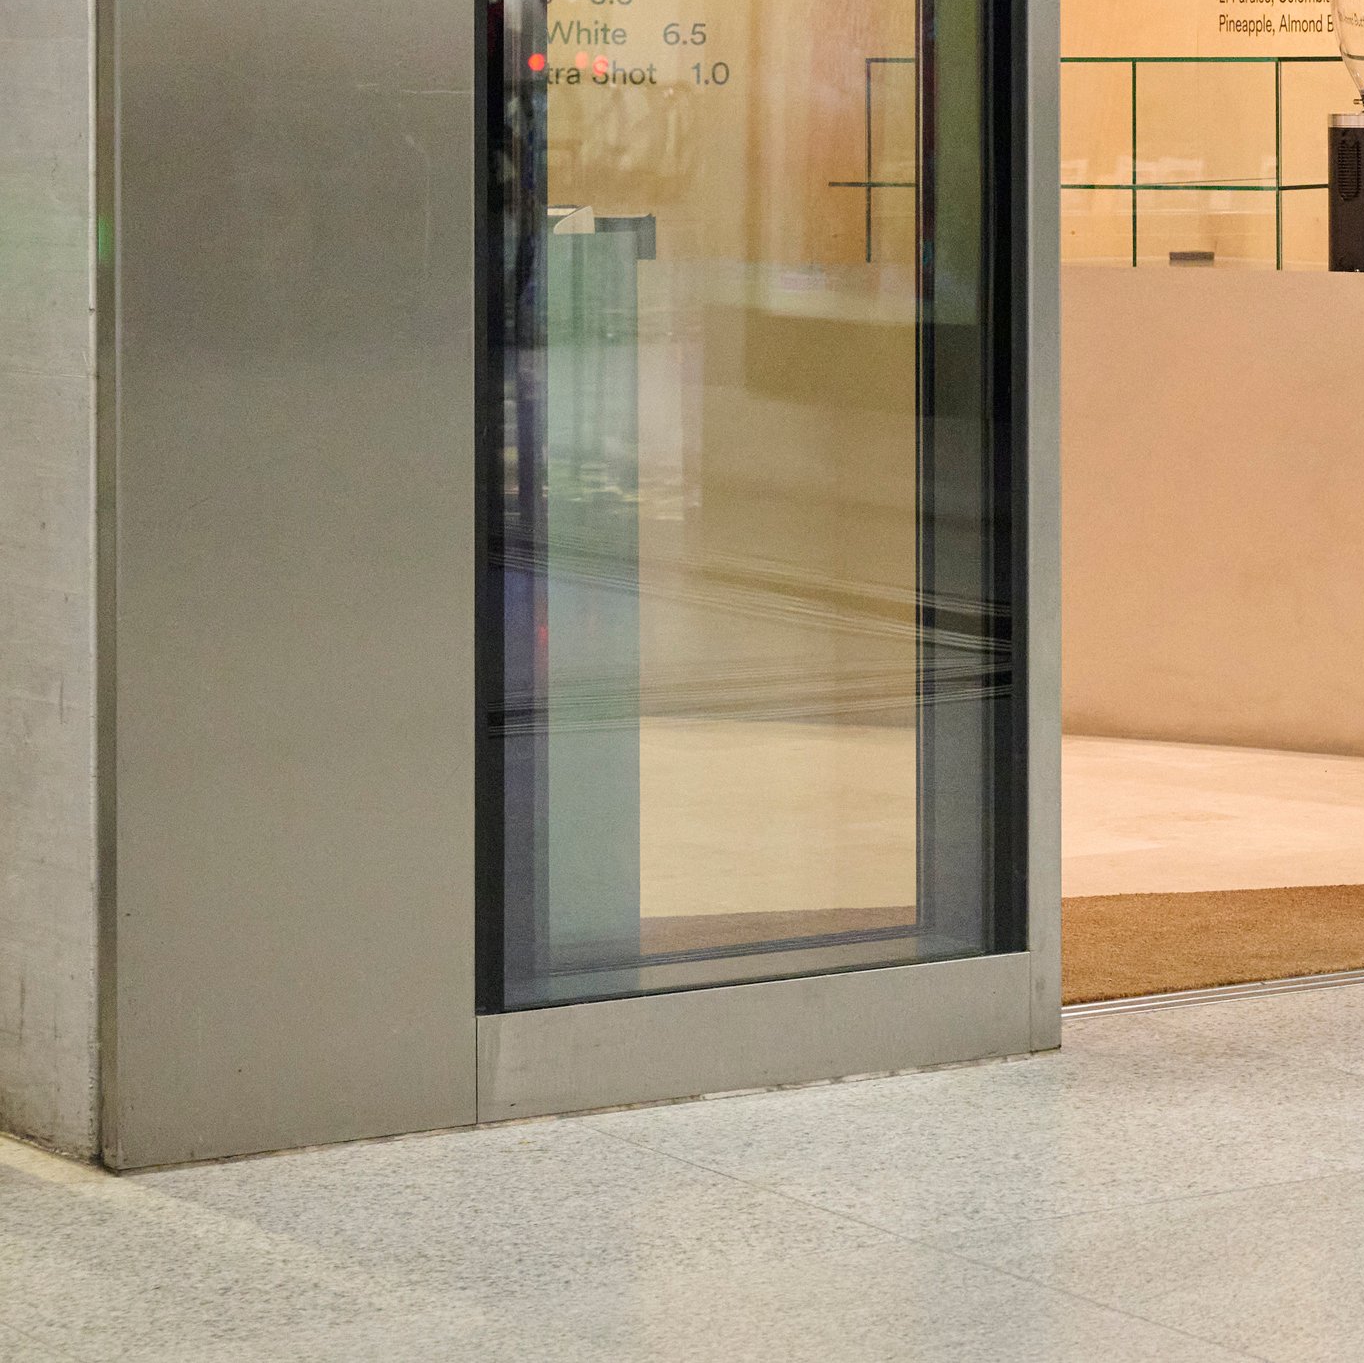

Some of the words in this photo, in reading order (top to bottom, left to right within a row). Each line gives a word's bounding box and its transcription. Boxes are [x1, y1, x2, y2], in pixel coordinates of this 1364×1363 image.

[663, 23, 707, 45] 6.5
[1218, 14, 1276, 36] Pineapple,
[1280, 14, 1323, 33] Almond
[692, 62, 730, 86] 1.0
